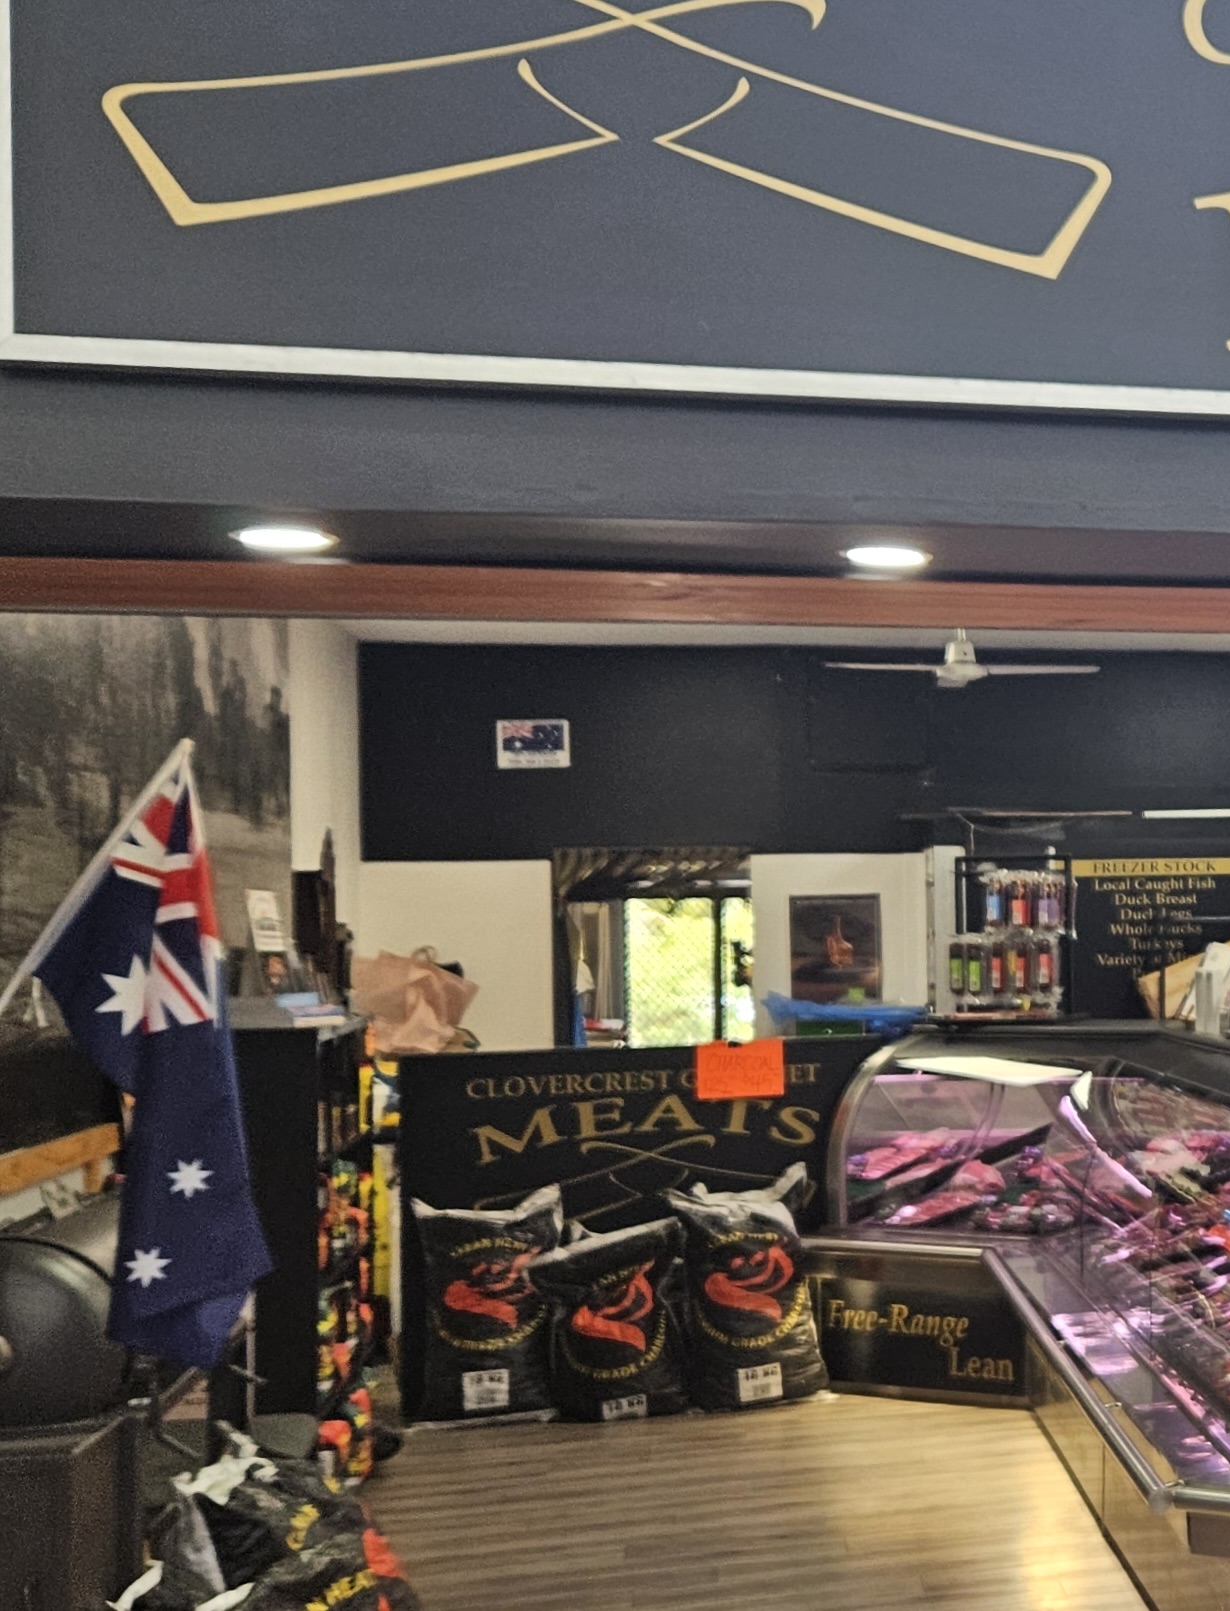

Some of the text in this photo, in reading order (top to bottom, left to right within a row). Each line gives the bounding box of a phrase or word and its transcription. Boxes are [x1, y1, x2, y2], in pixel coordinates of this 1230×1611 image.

[1092, 860, 1217, 873] FREEZER STOCK
[1094, 877, 1217, 892] Local Caught Fish
[1115, 892, 1198, 905] Duck Breast
[466, 1069, 673, 1099] CLOVERCREST
[468, 1093, 822, 1167] MEATS
[828, 1299, 969, 1347] Free-Range
[949, 1346, 1014, 1381] Lean
